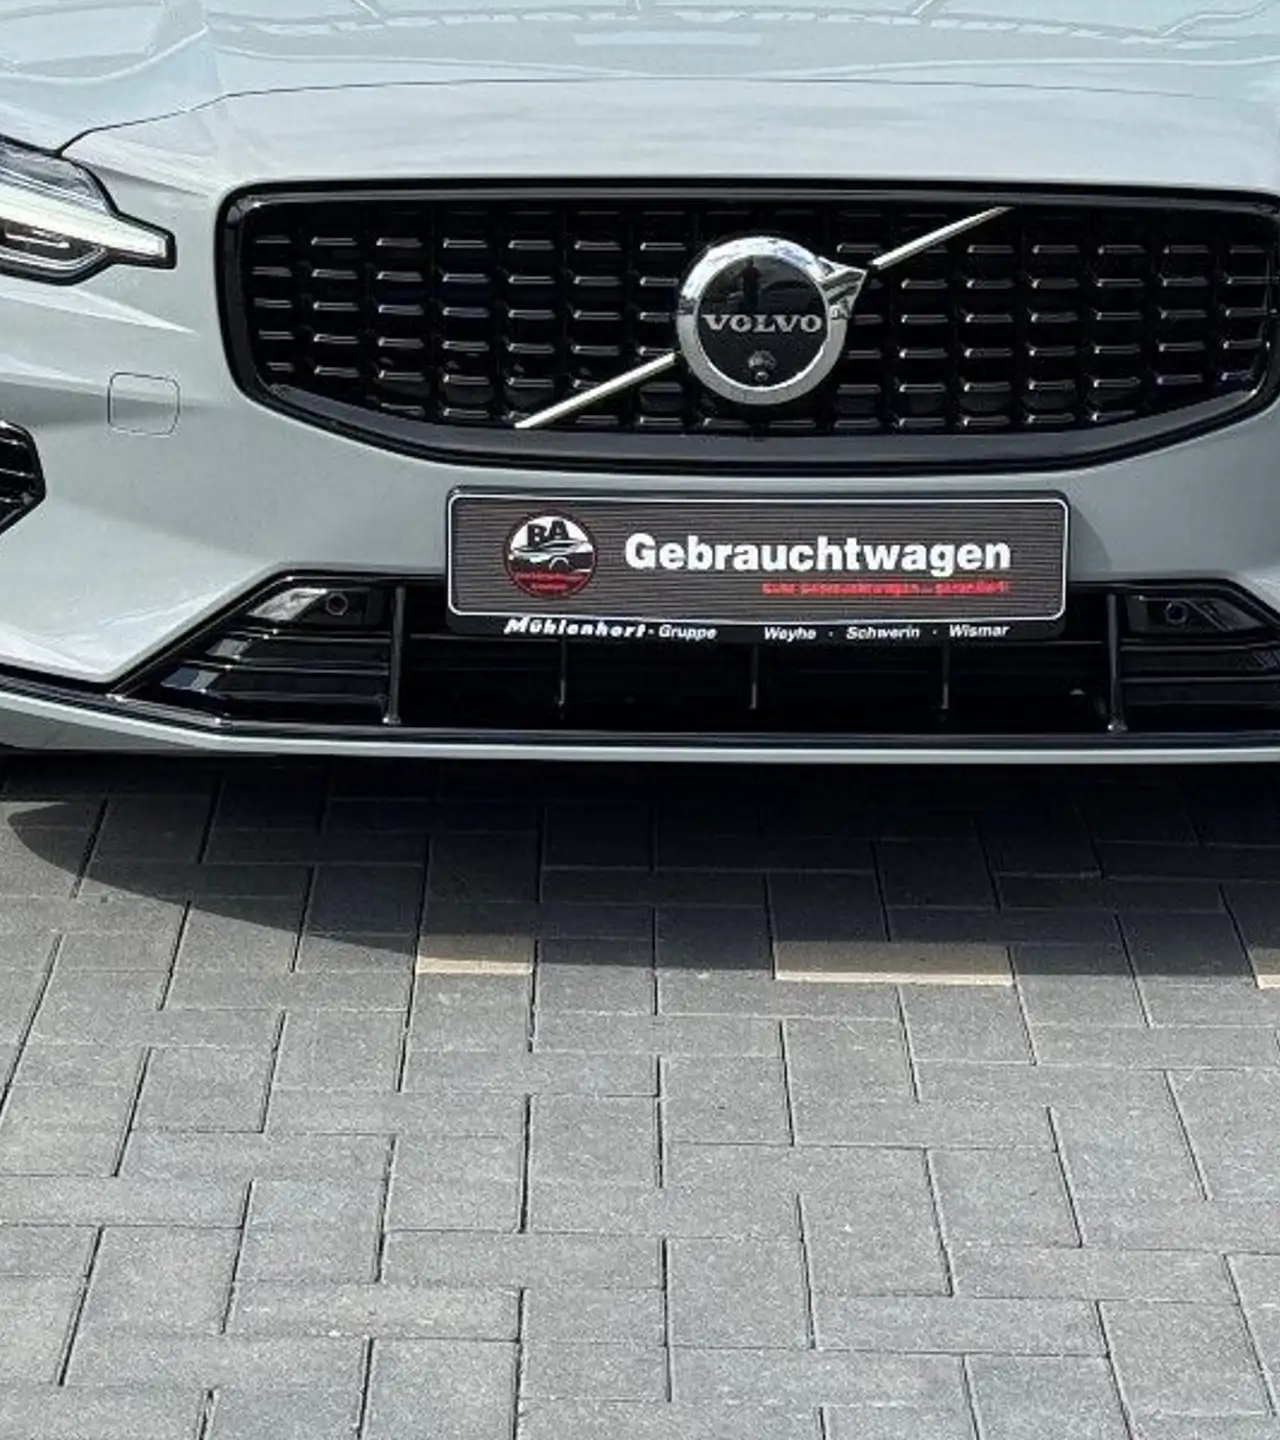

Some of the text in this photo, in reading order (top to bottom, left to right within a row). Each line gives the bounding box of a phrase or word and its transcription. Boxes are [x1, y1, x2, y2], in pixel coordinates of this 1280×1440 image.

[702, 314, 822, 333] VOLVO
[625, 532, 1011, 577] Gebrauchtwagen
[764, 626, 817, 641] Weyhe
[846, 626, 921, 639] Schwerin
[949, 623, 1010, 638] Wismar
